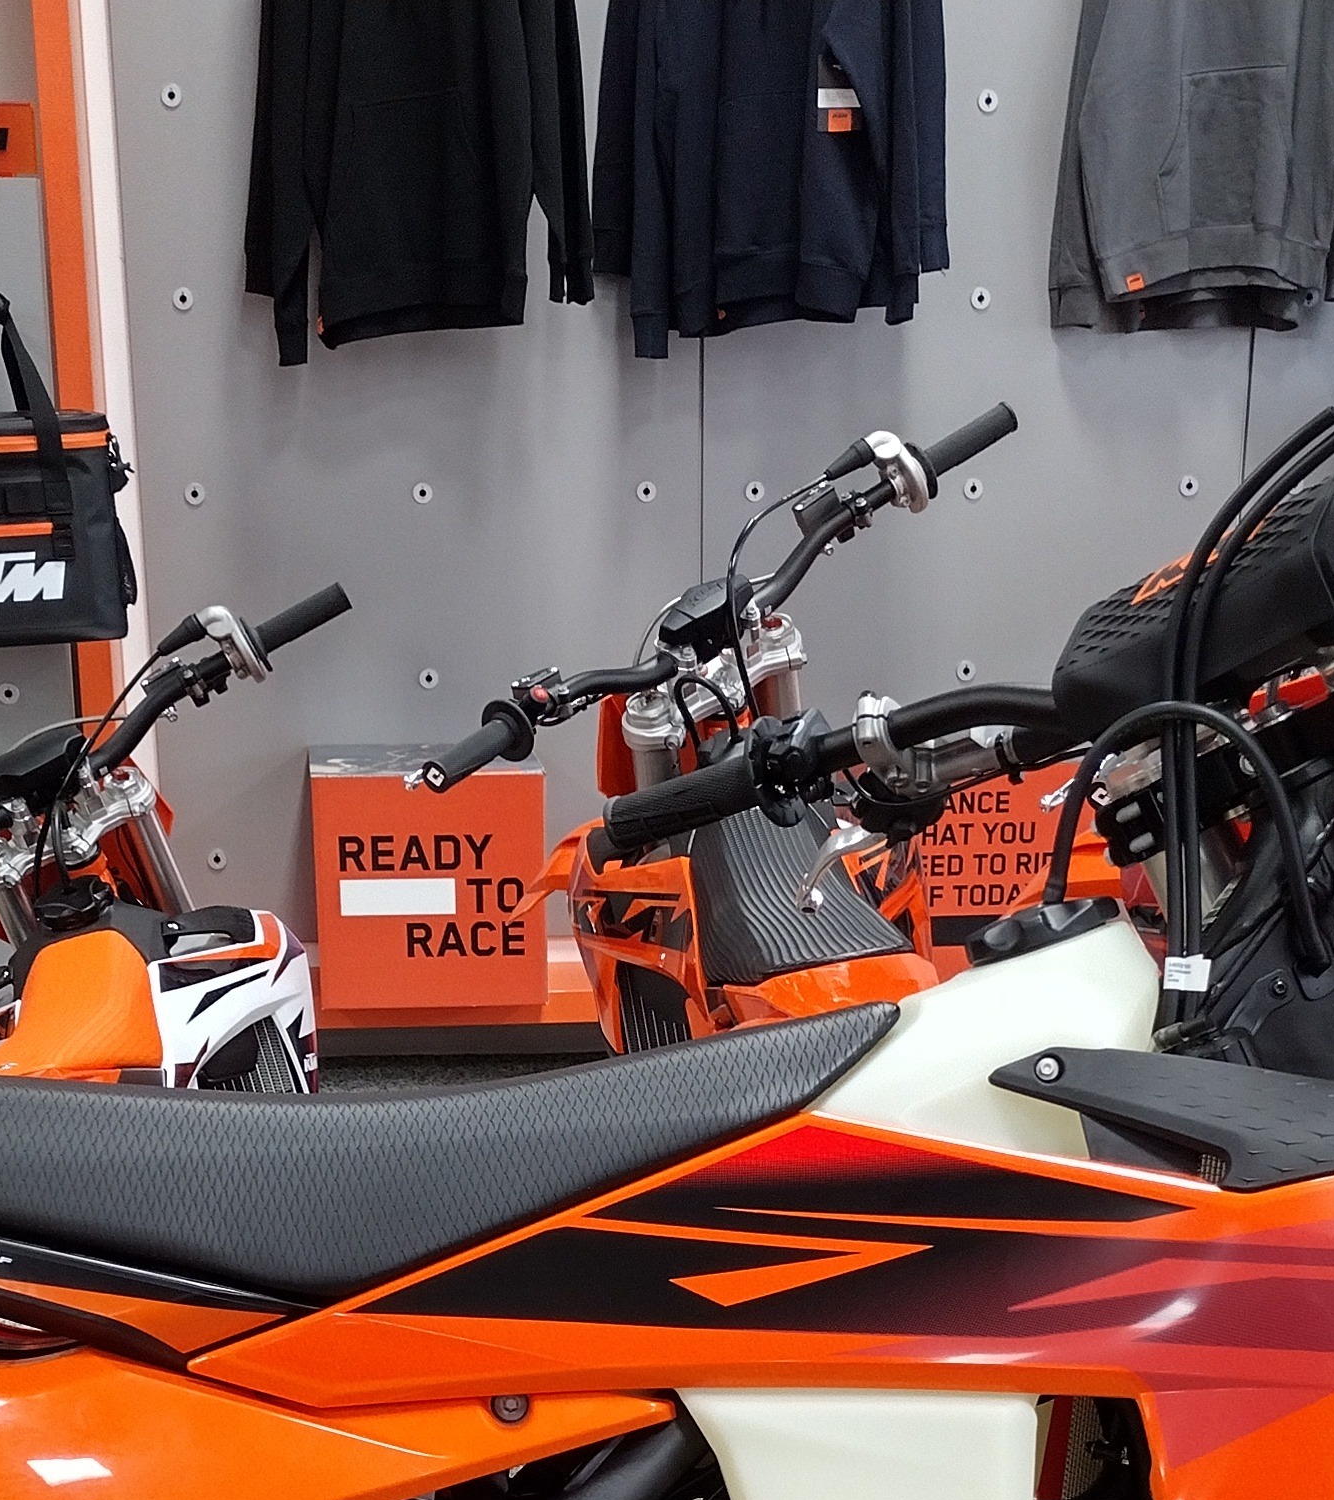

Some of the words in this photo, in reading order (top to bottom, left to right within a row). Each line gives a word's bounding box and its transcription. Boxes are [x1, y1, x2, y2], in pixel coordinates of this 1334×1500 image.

[945, 791, 1010, 814] ANCE
[922, 821, 974, 846] HAT
[982, 821, 1036, 844] YOU
[338, 834, 493, 872] READY
[923, 854, 964, 877] ED
[973, 852, 1006, 875] TO
[1016, 852, 1054, 875] RI
[466, 877, 525, 914] TO
[953, 883, 1028, 907] TODA
[406, 920, 525, 957] RACE
